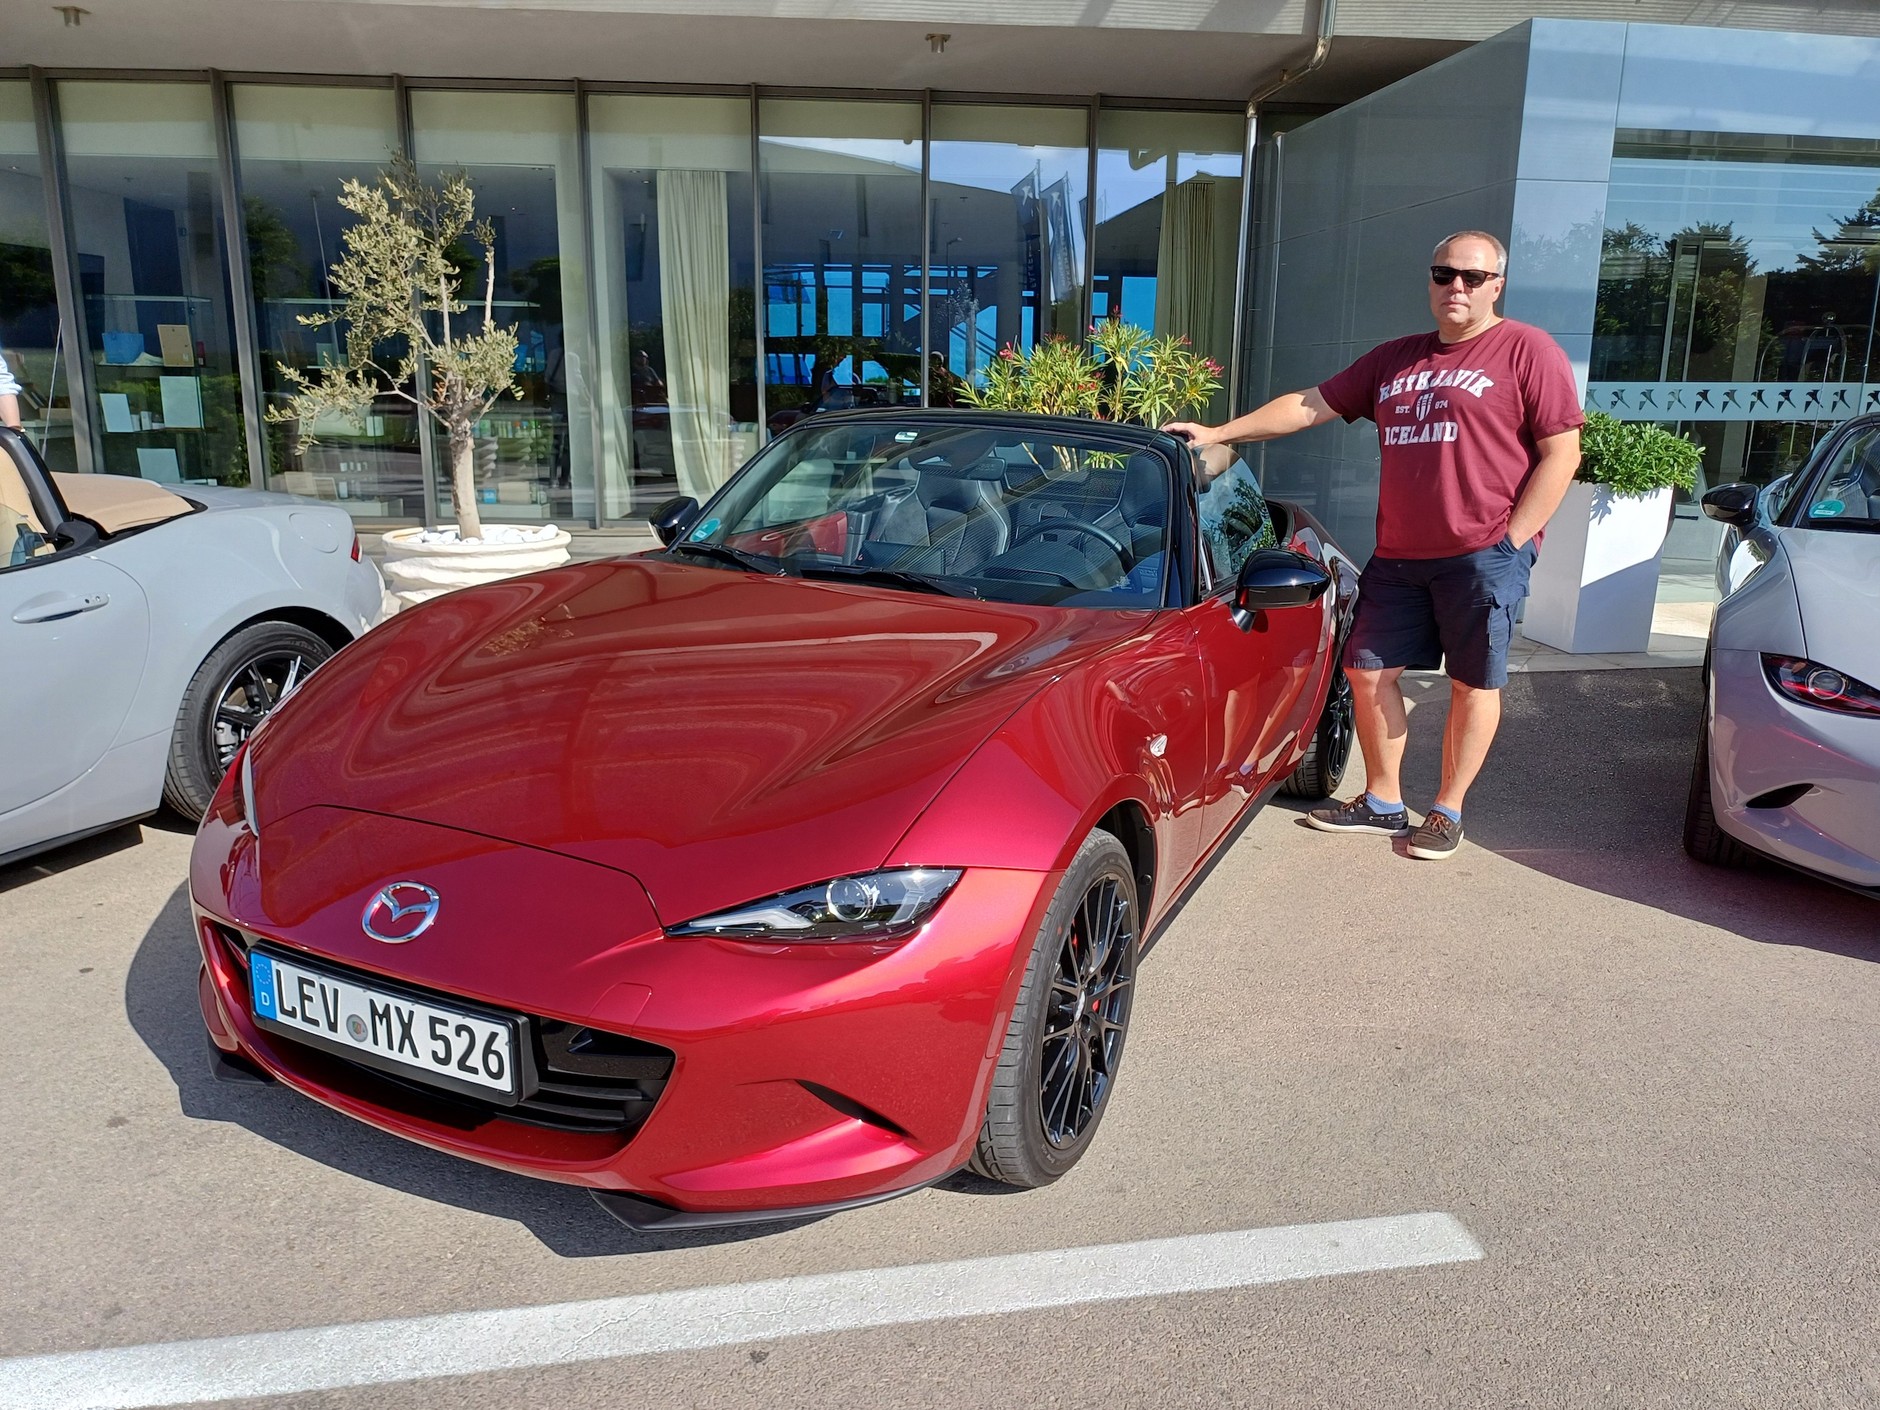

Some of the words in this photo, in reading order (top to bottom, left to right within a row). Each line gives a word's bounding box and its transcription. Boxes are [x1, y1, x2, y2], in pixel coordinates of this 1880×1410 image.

[1384, 422, 1458, 445] ICELAND
[261, 992, 270, 1006] D
[275, 968, 339, 1033] LEV
[369, 998, 420, 1059] MX
[428, 1015, 505, 1080] 526
